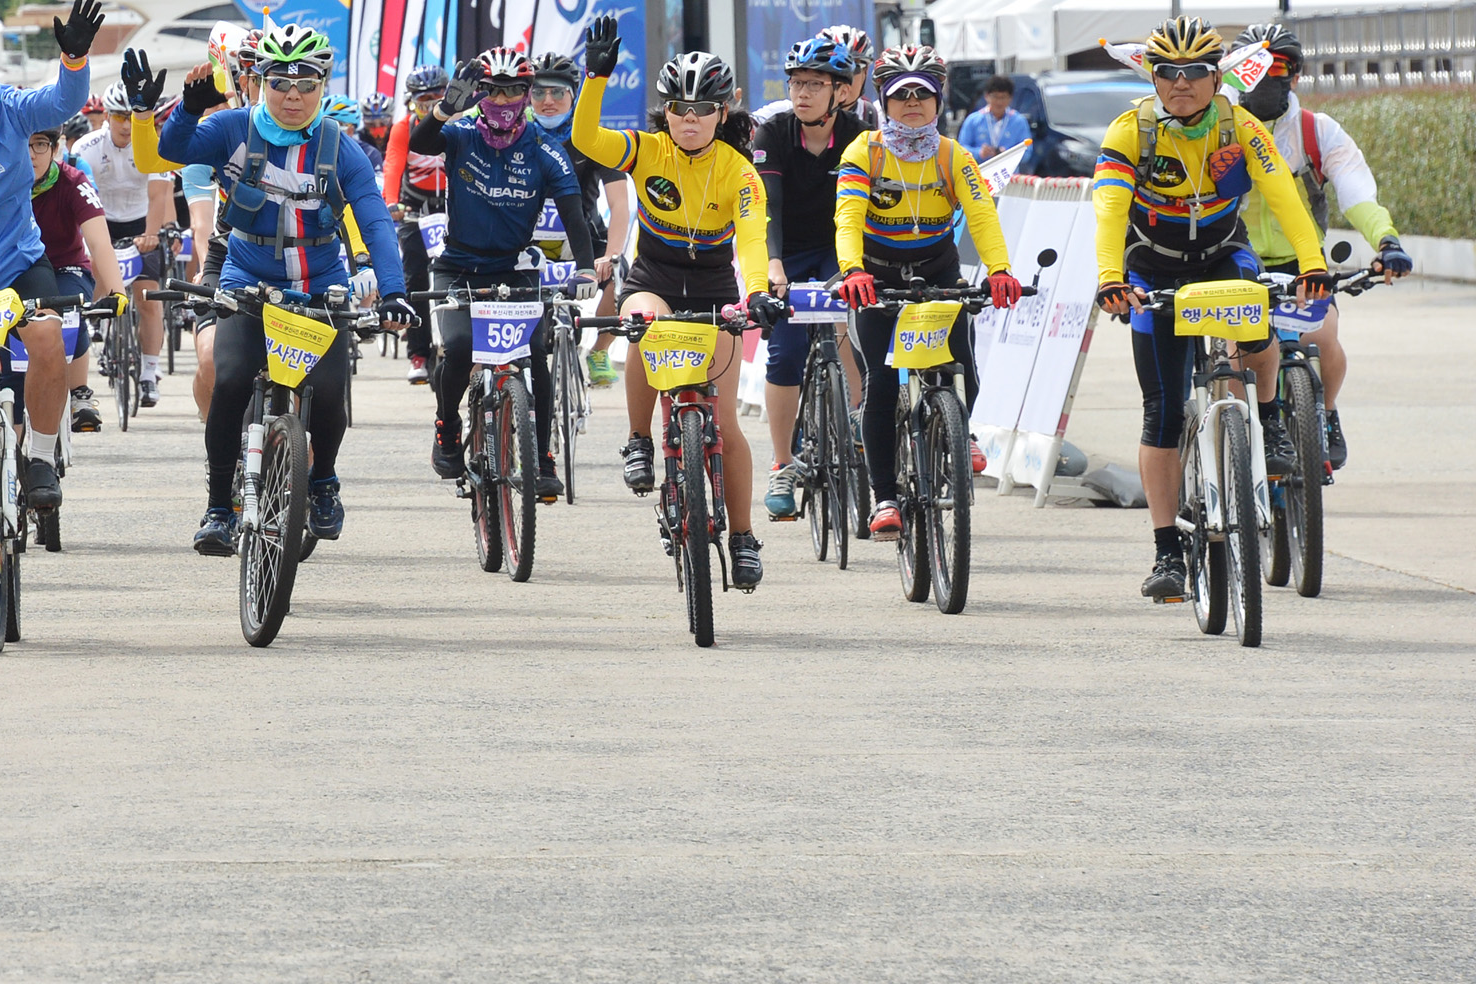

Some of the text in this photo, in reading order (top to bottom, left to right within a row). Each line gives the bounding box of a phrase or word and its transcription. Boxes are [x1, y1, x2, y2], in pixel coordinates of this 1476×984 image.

[503, 164, 533, 176] LEGACY
[540, 143, 571, 176] SUBARU
[474, 179, 537, 200] SUBARU
[1181, 303, 1263, 326] 행사진행
[487, 322, 526, 349] 596
[899, 325, 949, 353] 행사진행
[643, 348, 706, 374] 행사진행
